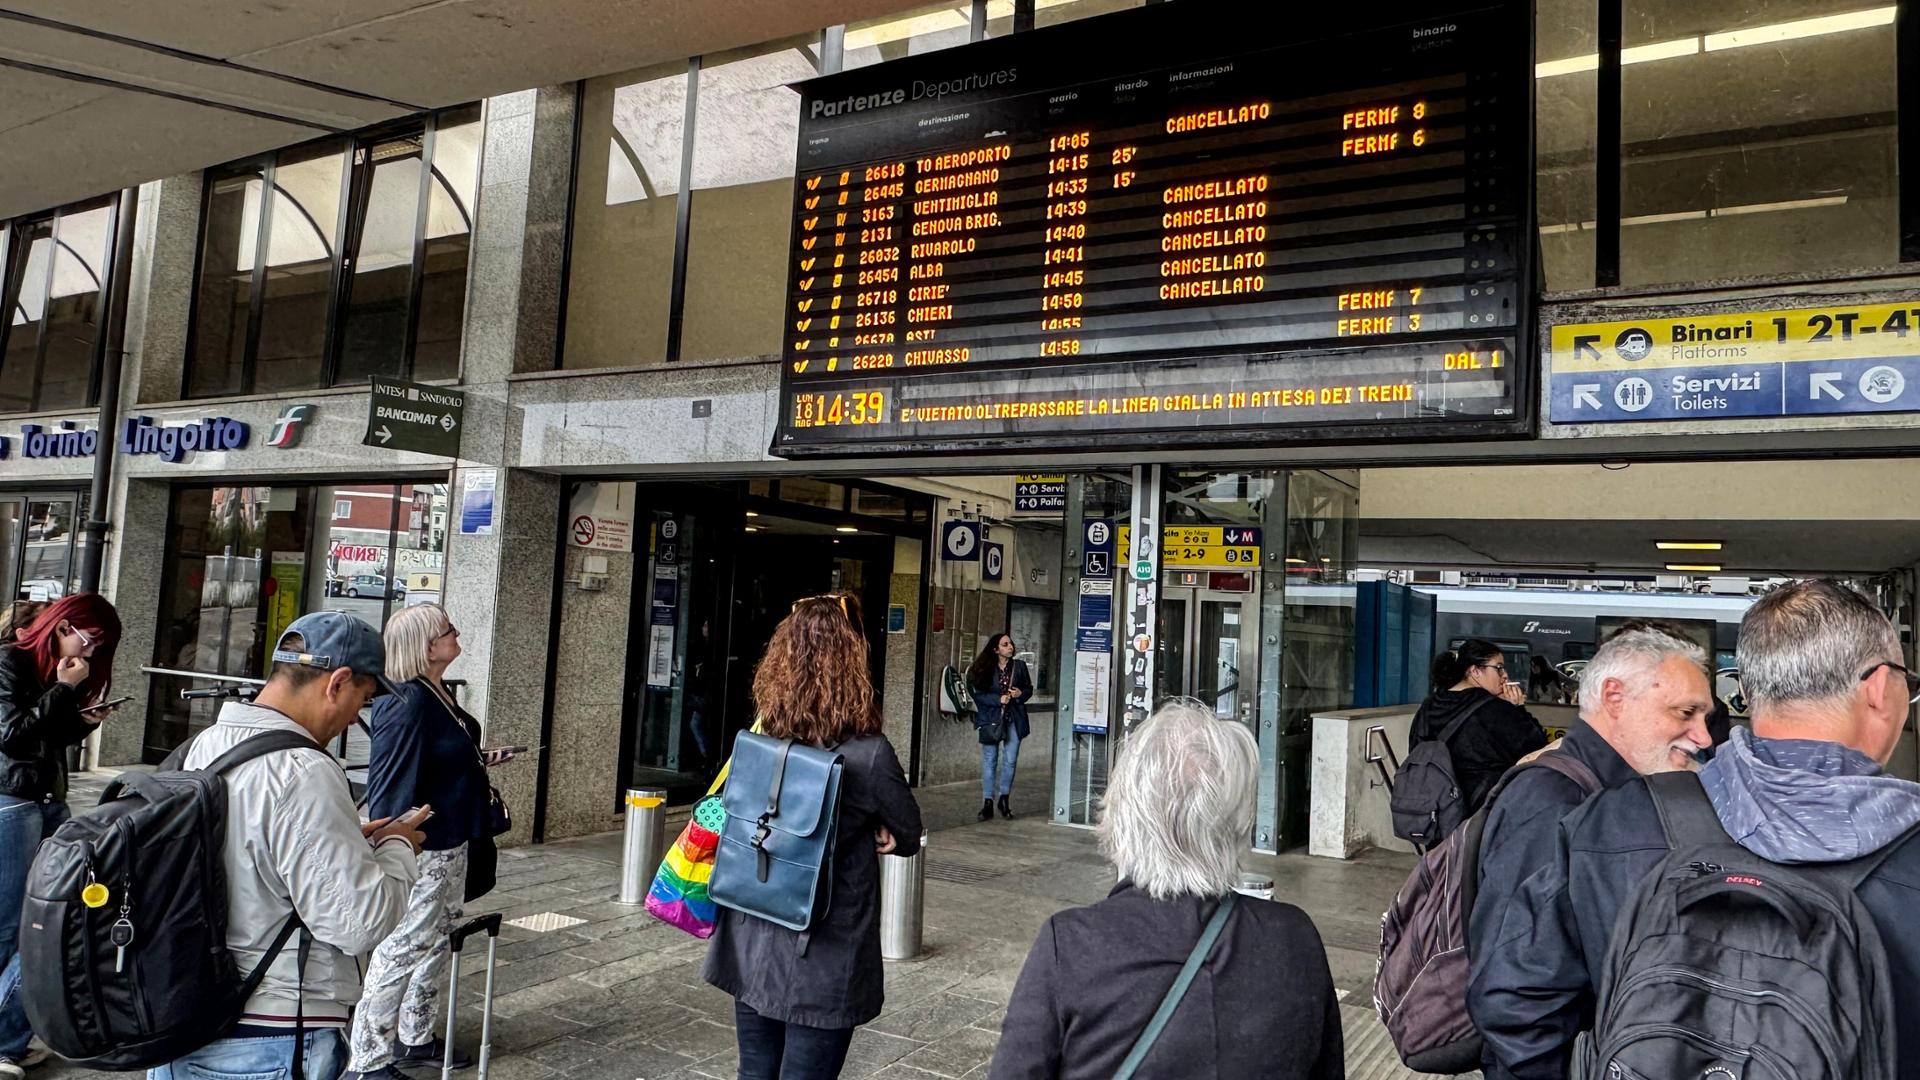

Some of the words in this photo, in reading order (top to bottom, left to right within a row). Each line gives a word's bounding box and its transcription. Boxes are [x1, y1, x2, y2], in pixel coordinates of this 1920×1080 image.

[1413, 23, 1457, 39] binario
[1169, 63, 1233, 82] informazioni
[811, 89, 905, 119] Partenze
[912, 68, 1017, 101] Departures
[1115, 79, 1149, 92] ritardo
[1050, 92, 1078, 104] orario
[918, 111, 970, 127] destinazione
[864, 182, 904, 202] 26445
[1049, 154, 1088, 174] 14:15
[1413, 102, 1425, 120] 8
[865, 162, 905, 182] 26618
[916, 158, 932, 173] TO
[935, 145, 1010, 170] AEROPORTO
[1050, 132, 1090, 152] 14:05
[1166, 103, 1269, 134] CANCELLATO
[862, 206, 894, 223] 3163
[914, 191, 998, 216] VENTIMIGLIA
[1047, 178, 1088, 198] 14:33
[1413, 129, 1425, 146] 6
[861, 226, 892, 243] 2131
[912, 216, 962, 236] GENOVA
[966, 212, 1002, 230] BRIG.
[1047, 200, 1087, 219] 14:39
[1163, 176, 1268, 204] CANCELLATO
[860, 247, 900, 265] 26032
[911, 238, 975, 258] RIVAROLO
[1046, 224, 1085, 242] 14:40
[1162, 201, 1266, 229] CANCELLATO
[858, 267, 898, 285] 26454
[910, 262, 943, 280] ALBA
[1044, 246, 1083, 265] 14:41
[1162, 226, 1266, 252] CANCELLATO
[857, 290, 897, 306] 26718
[1043, 270, 1084, 288] 14:45
[1161, 252, 1265, 277] CANCELLATO
[856, 310, 895, 327] 26136
[908, 305, 952, 323] CHIERI
[1042, 292, 1082, 311] 14:50
[1160, 276, 1264, 300] CANCELLATO
[1410, 288, 1422, 305] 7
[1672, 320, 1752, 342] Binari
[1772, 317, 1786, 344] 1
[853, 353, 894, 370] 26220
[904, 348, 971, 367] CHIVASSO
[1040, 339, 1082, 356] 14:58
[1408, 314, 1422, 332] 3
[1672, 343, 1747, 360] Platforms
[1442, 351, 1483, 371] DAL
[1489, 350, 1501, 368] 1
[375, 384, 405, 399] INTESA
[1672, 371, 1760, 393] Servizi
[796, 393, 813, 403] LUN
[815, 391, 884, 426] 14:39
[916, 404, 974, 422] VIETATO
[974, 399, 1085, 420] OLTREPASSARE
[1087, 398, 1109, 415] LA
[1110, 394, 1160, 414] LINEA
[1161, 392, 1224, 411] GIALLA
[1226, 390, 1247, 409] IN
[1250, 387, 1316, 408] ATTESA
[1318, 385, 1354, 405] DEI
[1356, 383, 1414, 402] TRENI
[1672, 394, 1727, 411] Toilets
[376, 406, 438, 425] BANCOMAT
[796, 403, 813, 419] 18
[21, 420, 98, 459] Torino
[120, 415, 250, 464] Lingotto
[1242, 531, 1253, 543] M
[1184, 548, 1206, 559] 2-9
